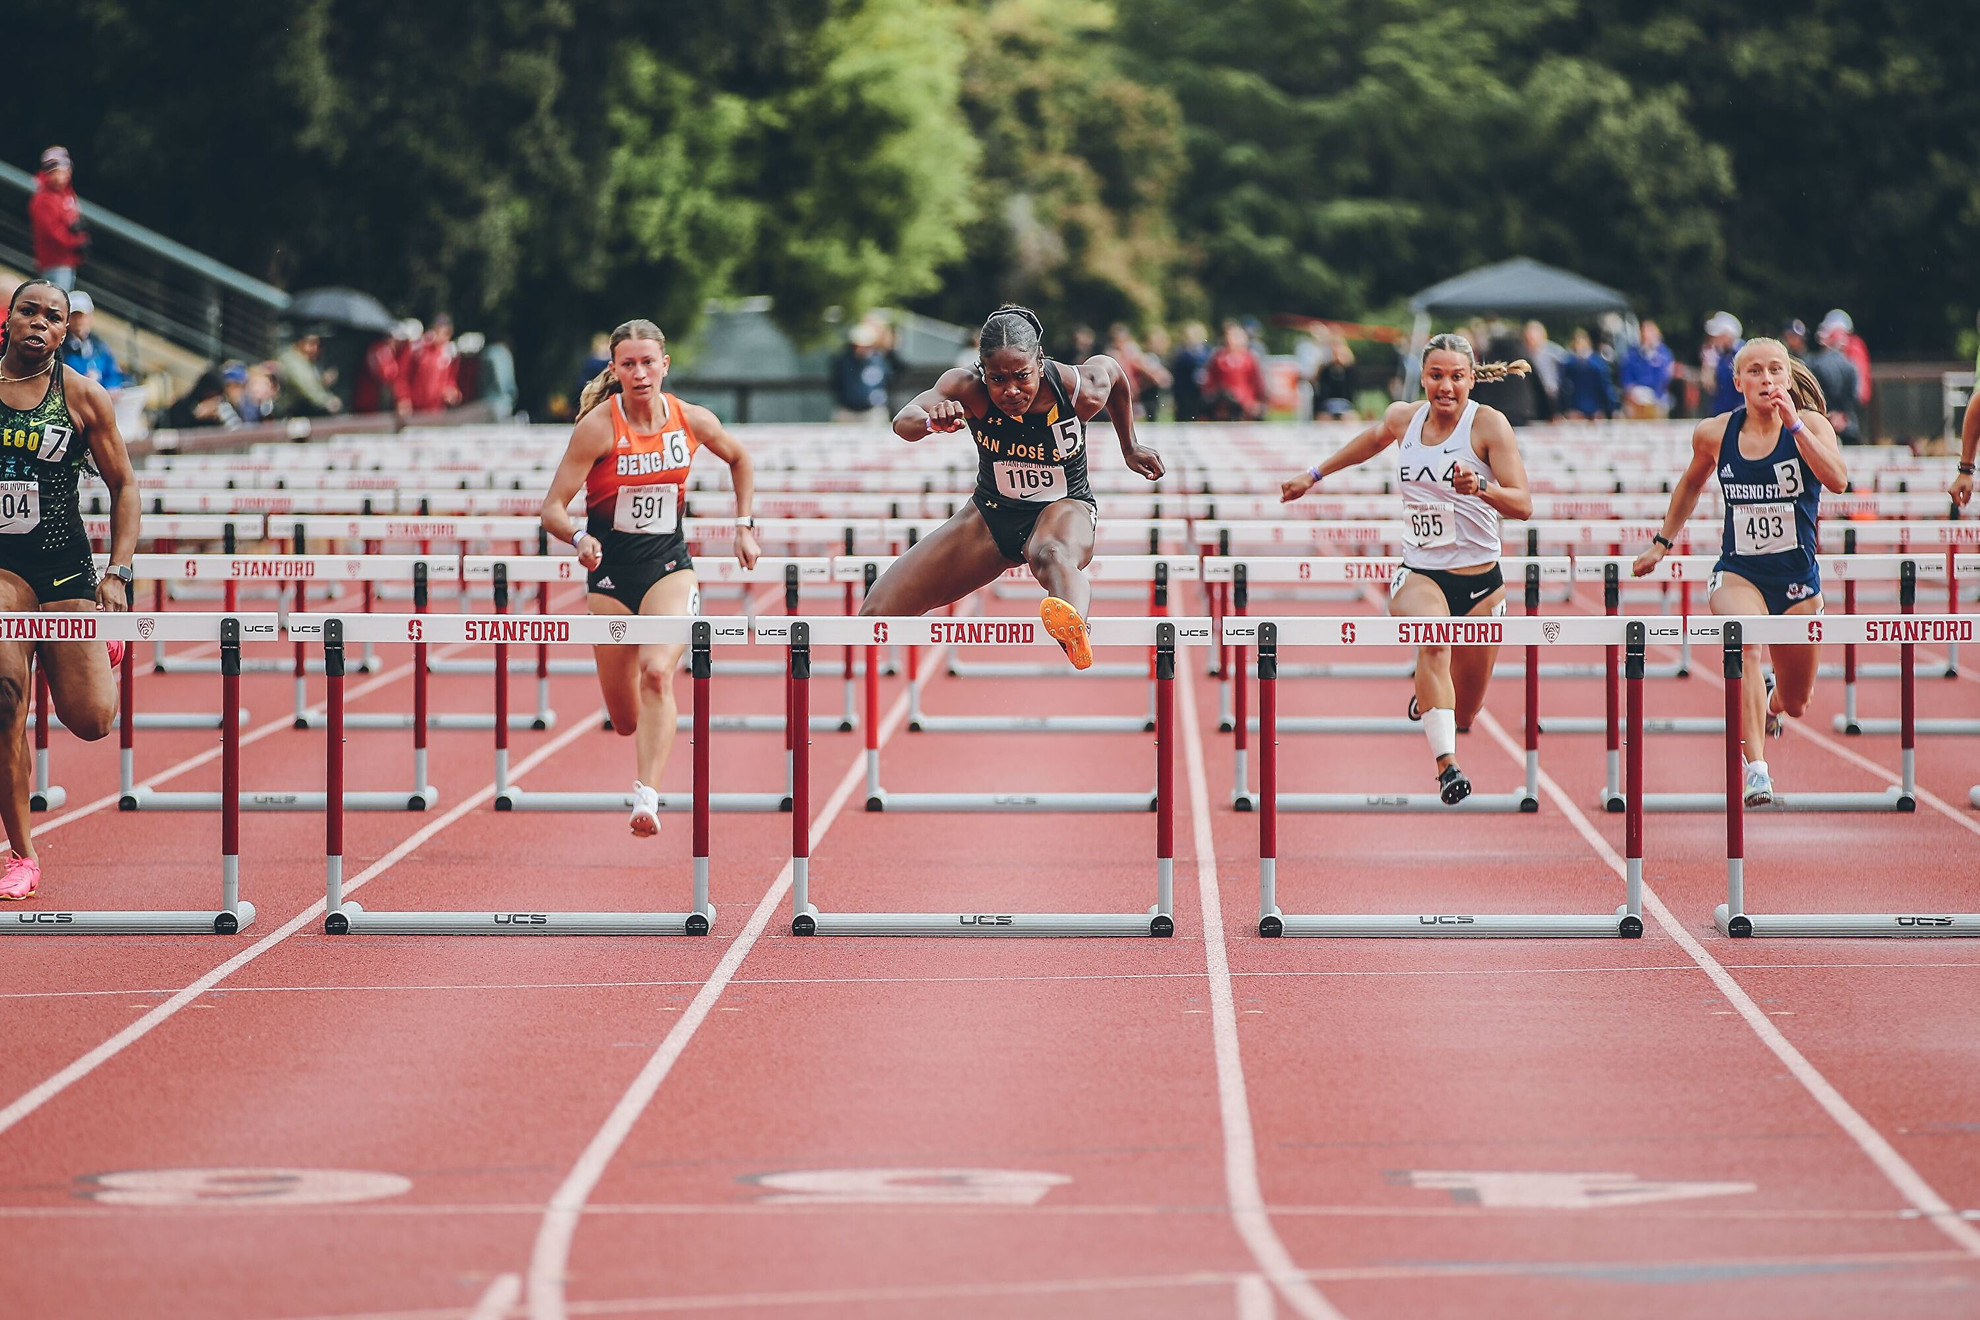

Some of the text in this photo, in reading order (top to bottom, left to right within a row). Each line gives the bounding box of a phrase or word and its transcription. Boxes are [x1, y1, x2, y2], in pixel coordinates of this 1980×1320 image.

[4, 428, 39, 450] EGO
[46, 428, 68, 460] 7
[977, 430, 1000, 453] SAN
[1007, 442, 1044, 461] JOSÉ
[1059, 421, 1079, 454] 5
[671, 434, 684, 463] 6
[1005, 469, 1054, 489] 1169
[1442, 461, 1457, 487] 4
[1781, 464, 1799, 494] 3
[1724, 484, 1763, 500] FRESNO
[632, 496, 663, 519] 591
[1412, 514, 1443, 536] 655
[1746, 516, 1784, 539] 493
[232, 560, 315, 578] STANFORD
[465, 620, 569, 641] STANFORD
[930, 622, 1034, 644] STANFORD
[1399, 623, 1502, 643] STANFORD
[1649, 628, 1679, 636] UCS
[1866, 620, 1972, 641] STANFORD
[19, 913, 73, 924] UCS
[494, 913, 548, 925] UCS
[959, 915, 1014, 925] UCS
[1419, 915, 1475, 925] UCS
[1897, 917, 1954, 926] UCS
